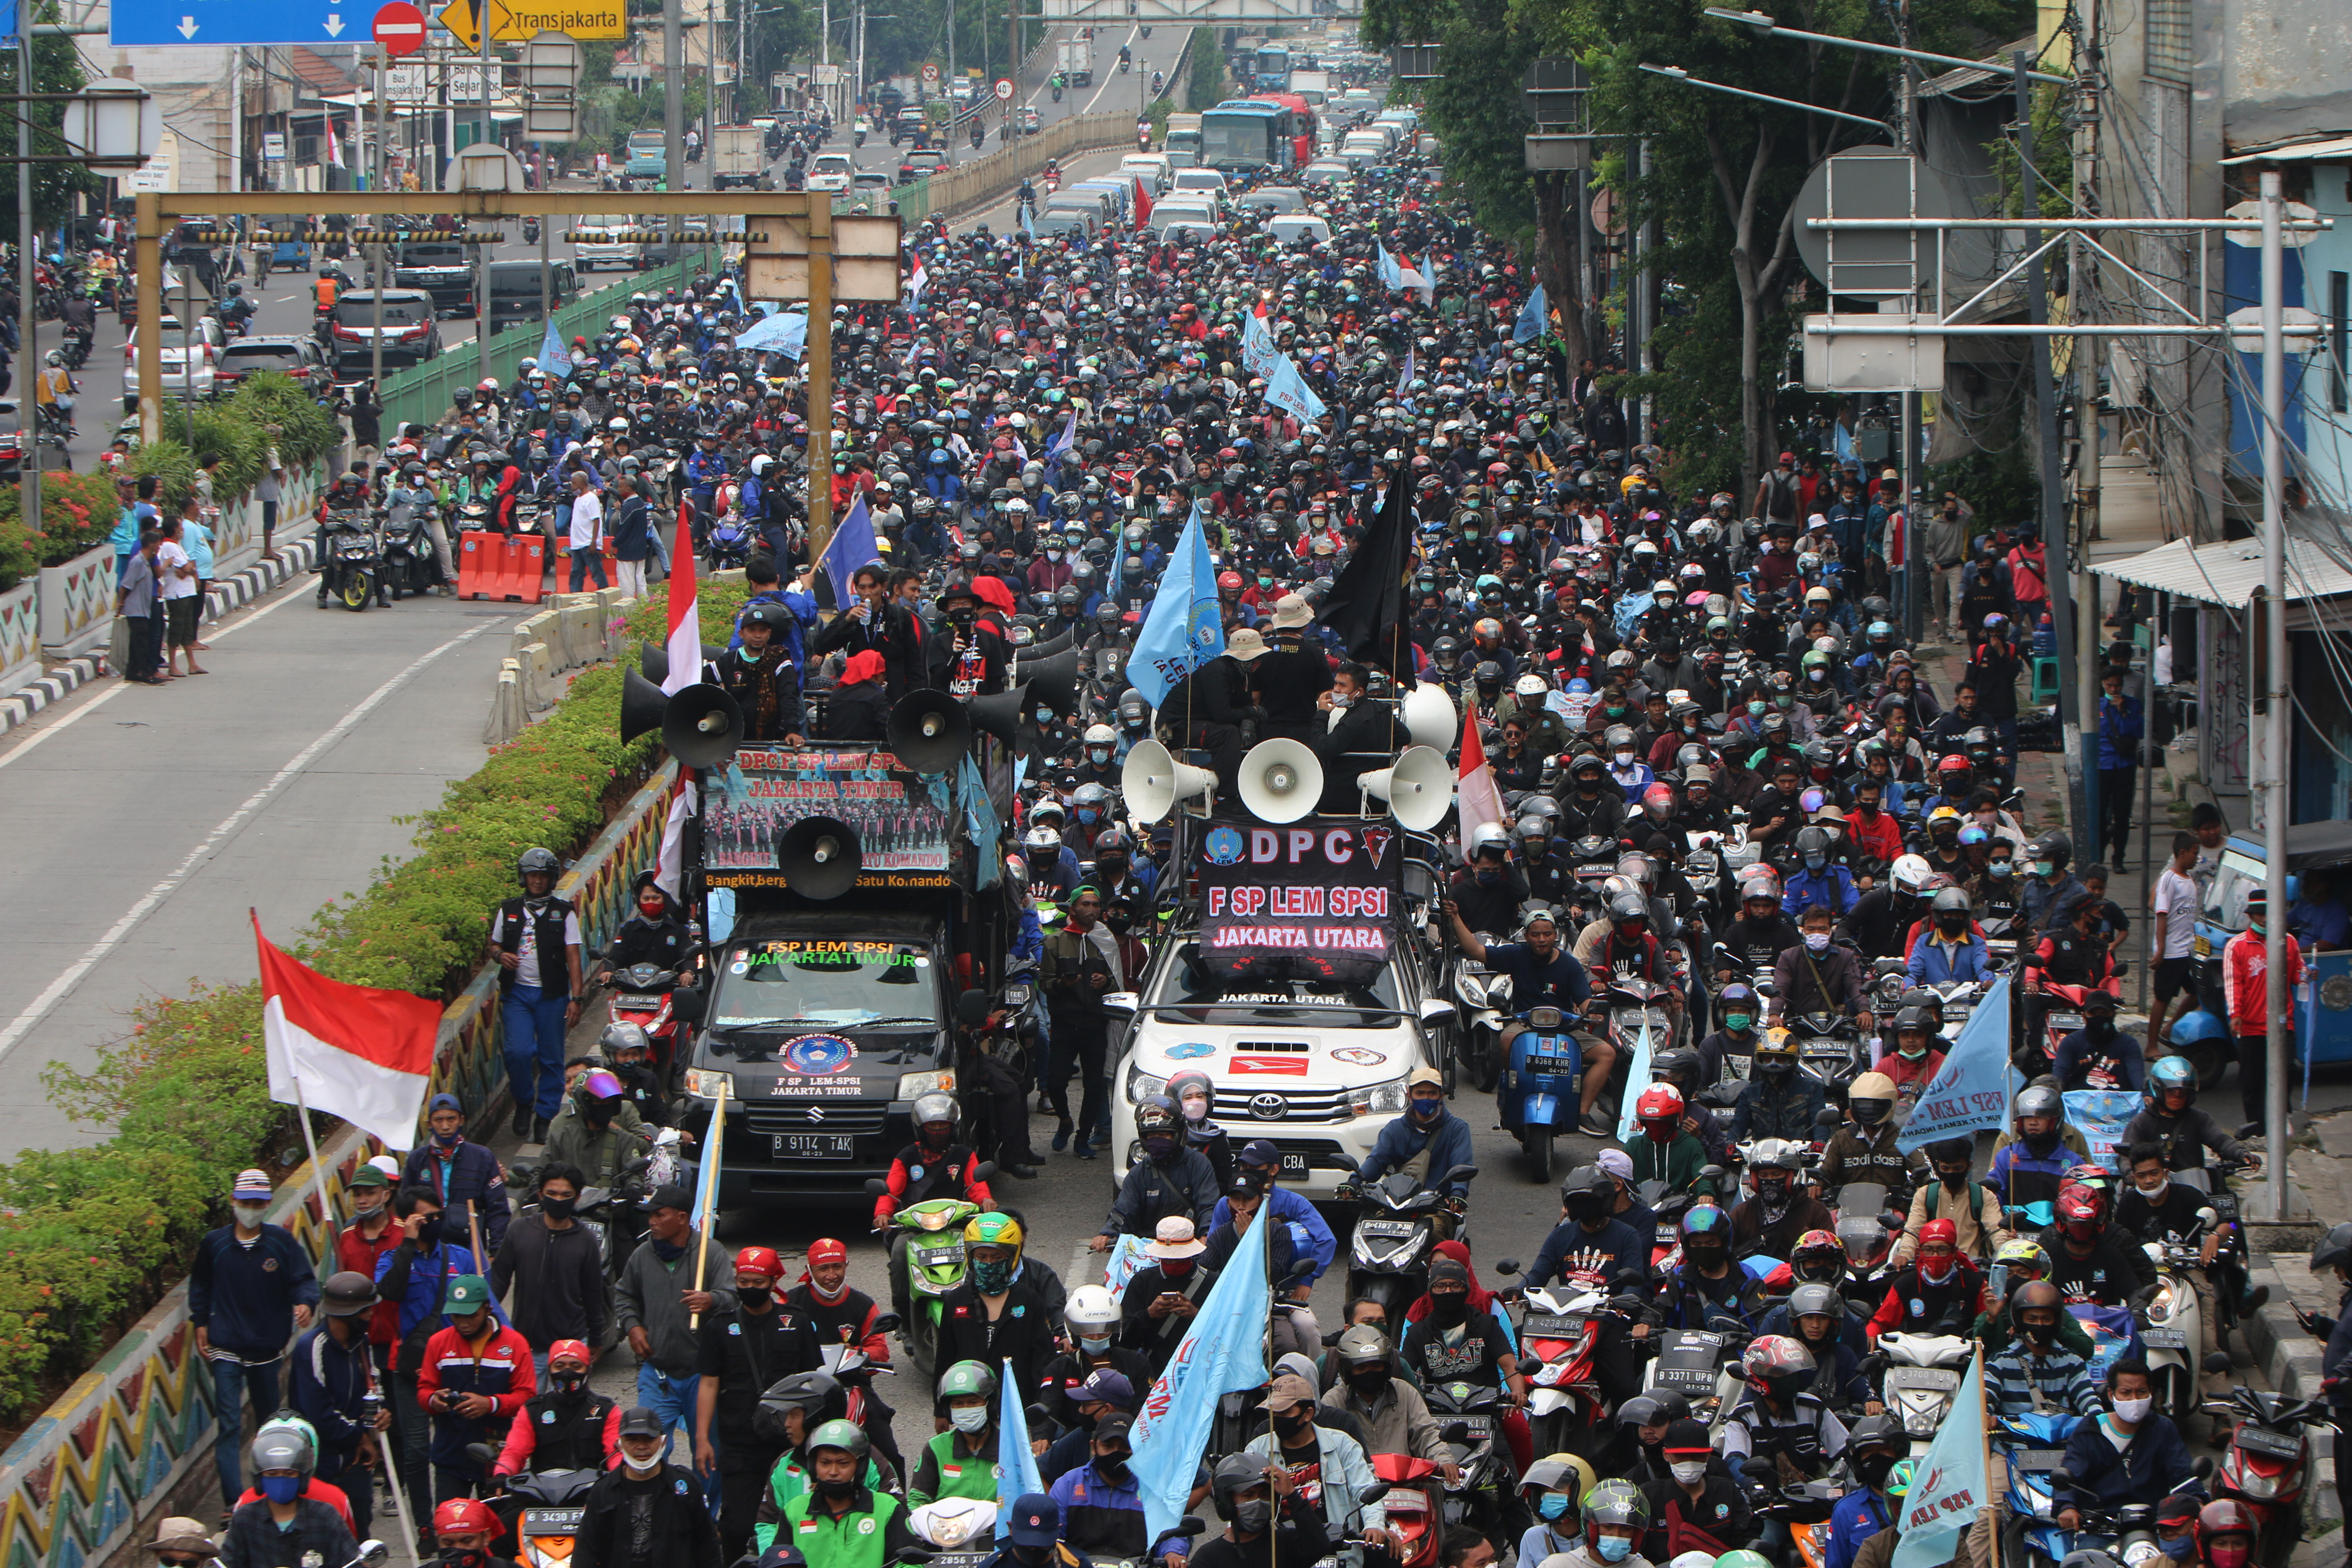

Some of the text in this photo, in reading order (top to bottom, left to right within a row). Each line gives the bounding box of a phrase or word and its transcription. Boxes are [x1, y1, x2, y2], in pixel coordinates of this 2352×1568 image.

[515, 11, 617, 31] Transjakarta
[393, 75, 406, 83] Bus
[385, 86, 423, 96] ansjakata
[454, 81, 499, 95] Separor
[998, 85, 1007, 93] 40
[1279, 392, 1292, 406] FSP
[1201, 629, 1211, 644] SPSI
[739, 752, 911, 771] DPC F SP LEM SPS
[748, 781, 905, 799] JAKARTA TIMUR
[719, 852, 771, 866] BANGKIT
[862, 852, 943, 868] ATU KOMANDO
[856, 875, 884, 887] Satu
[1210, 886, 1388, 917] F SP LEM SPSI
[1213, 927, 1384, 948] JAKARTA UTARA
[767, 941, 894, 953] FSP LEM SPSI
[1218, 994, 1346, 1006] JAKARTA UTARA
[778, 1033, 858, 1058] DEWAN PIMPINAN CABANG
[1535, 1057, 1552, 1065] 6368
[1555, 1058, 1569, 1067] KHR
[778, 1077, 861, 1086] F SP LEM-SPSI
[771, 1087, 862, 1096] JAKARTA TIMUR
[774, 1136, 851, 1151] B 9114 TAK
[1284, 1155, 1304, 1169] CBA
[931, 1248, 951, 1256] 3308
[1528, 1318, 1581, 1329] B 4238 FPG
[1702, 1333, 1719, 1344] MM27
[1659, 1370, 1689, 1381] B 3371
[1896, 1369, 1901, 1377] B
[1907, 1370, 1929, 1378] 3700
[1468, 1419, 1486, 1428] KIY
[542, 1513, 567, 1522] 3430
[941, 1556, 966, 1564] 2856
